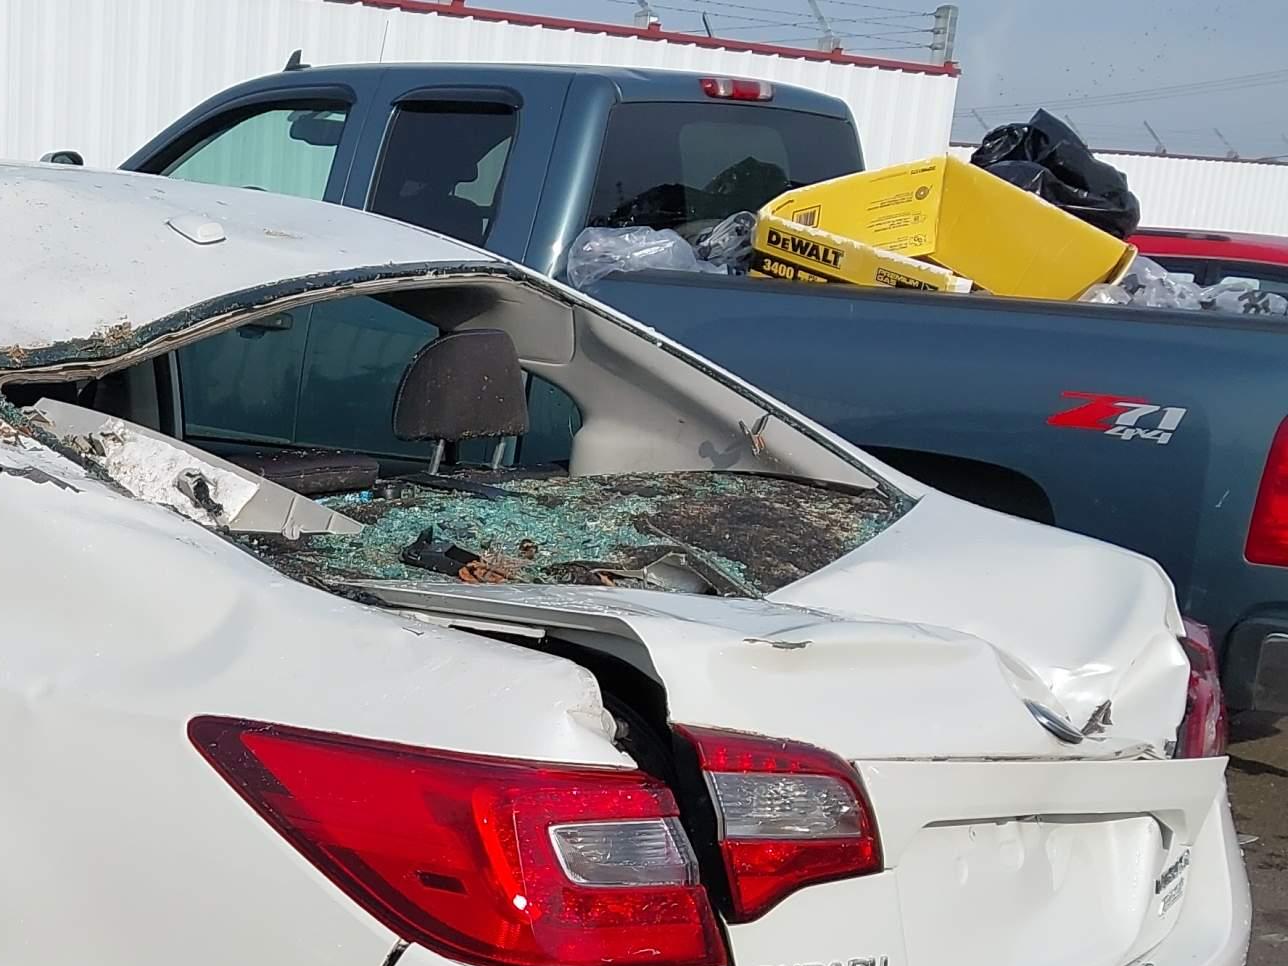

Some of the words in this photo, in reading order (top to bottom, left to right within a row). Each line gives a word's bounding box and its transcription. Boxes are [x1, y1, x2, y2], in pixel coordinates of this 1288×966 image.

[762, 258, 795, 280] 3400
[878, 268, 920, 288] PREMIUM
[876, 274, 898, 286] GAS
[1046, 390, 1187, 430] Z71
